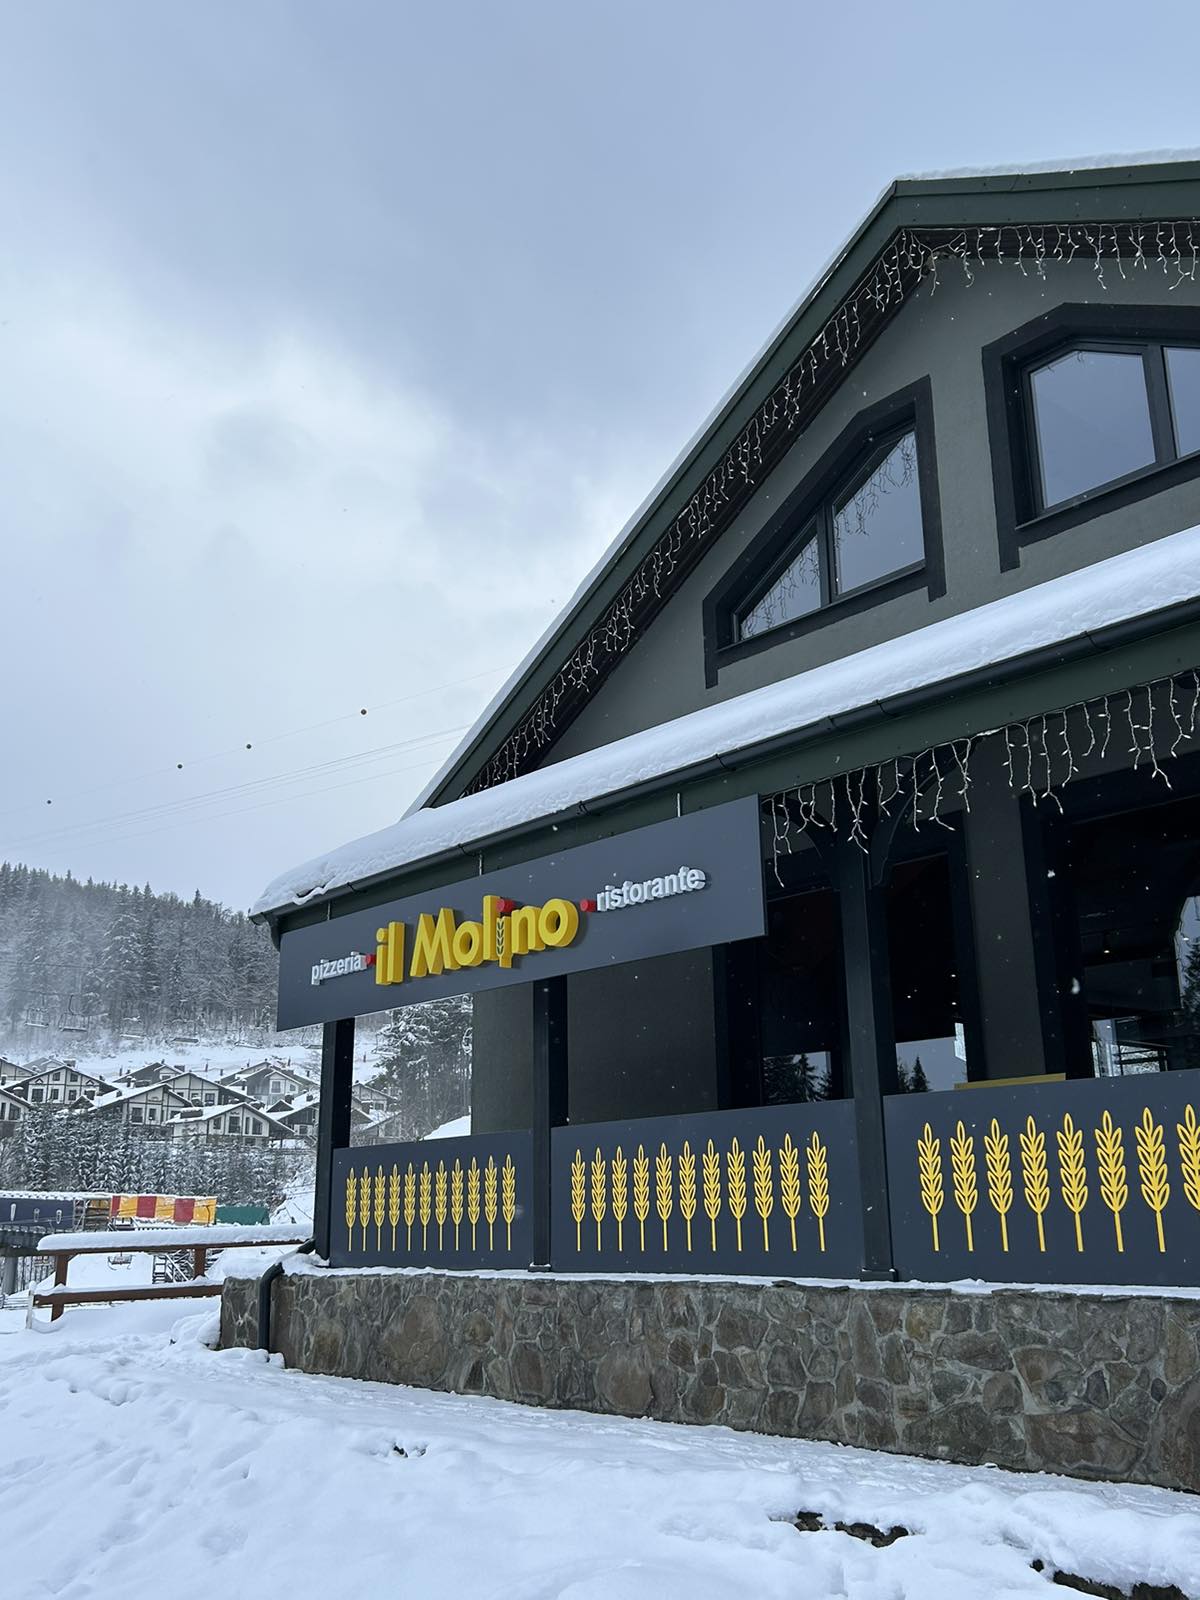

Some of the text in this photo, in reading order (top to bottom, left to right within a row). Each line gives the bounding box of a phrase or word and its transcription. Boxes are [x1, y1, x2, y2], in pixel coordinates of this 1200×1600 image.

[311, 865, 707, 986] pizzeria il Molino ristorante
